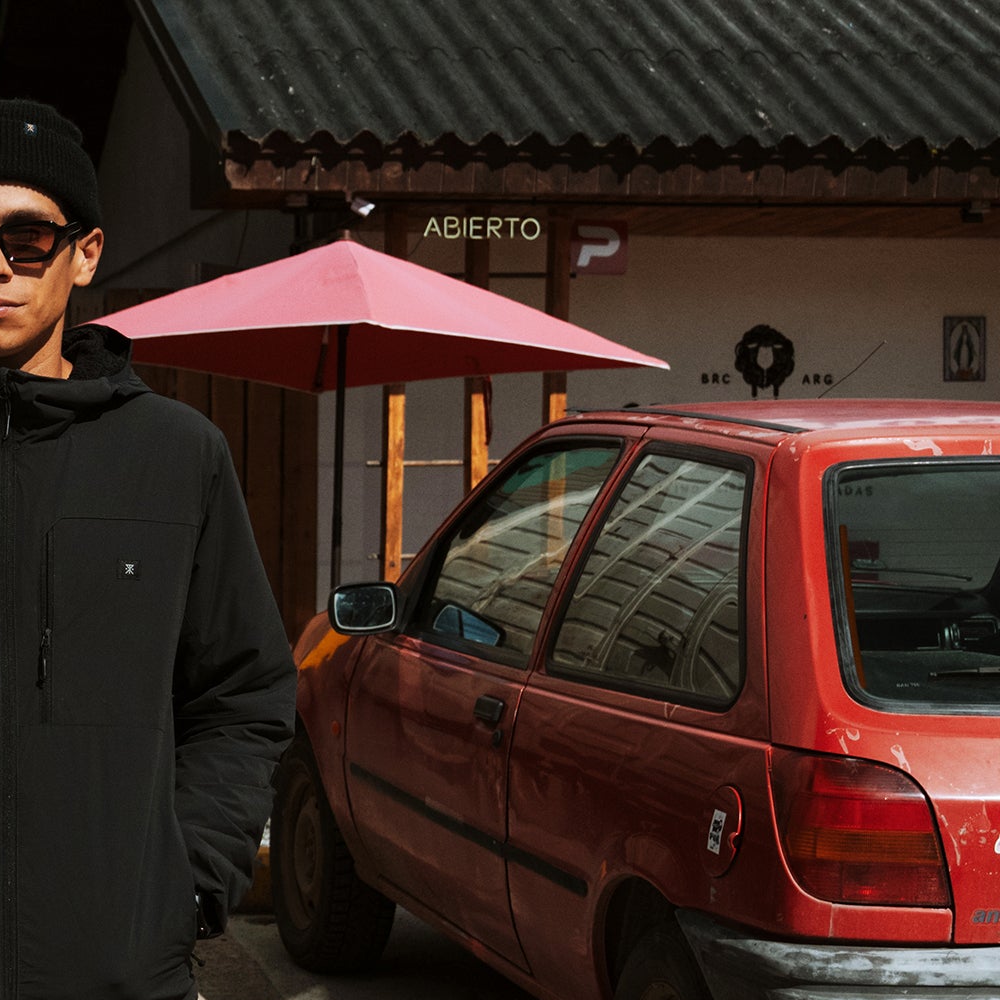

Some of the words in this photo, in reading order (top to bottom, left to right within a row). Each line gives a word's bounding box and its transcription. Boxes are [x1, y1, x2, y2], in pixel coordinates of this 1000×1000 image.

[423, 215, 541, 241] ABIERTO
[576, 225, 621, 268] P
[700, 372, 731, 384] BRC
[801, 373, 834, 385] ARG
